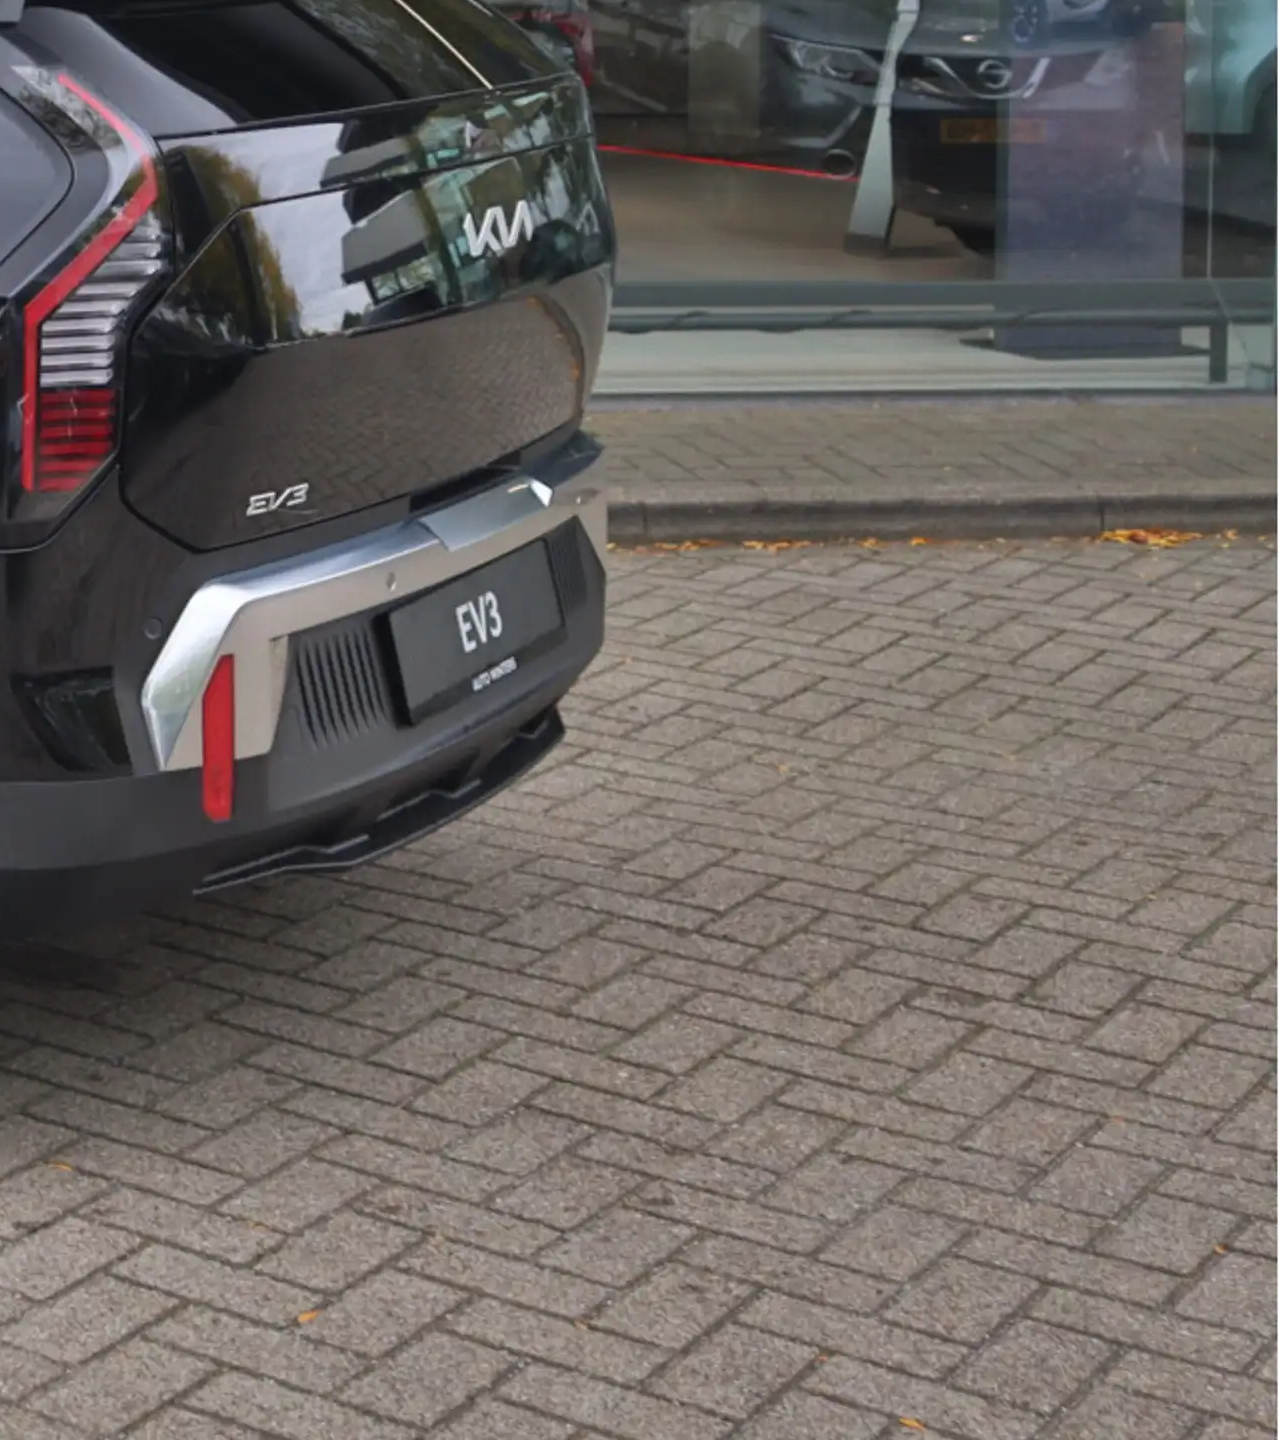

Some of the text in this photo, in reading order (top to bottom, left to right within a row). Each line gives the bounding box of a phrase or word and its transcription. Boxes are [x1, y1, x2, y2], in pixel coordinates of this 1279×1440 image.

[462, 199, 534, 258] KIA
[245, 482, 309, 517] EV3
[454, 590, 503, 654] EV3
